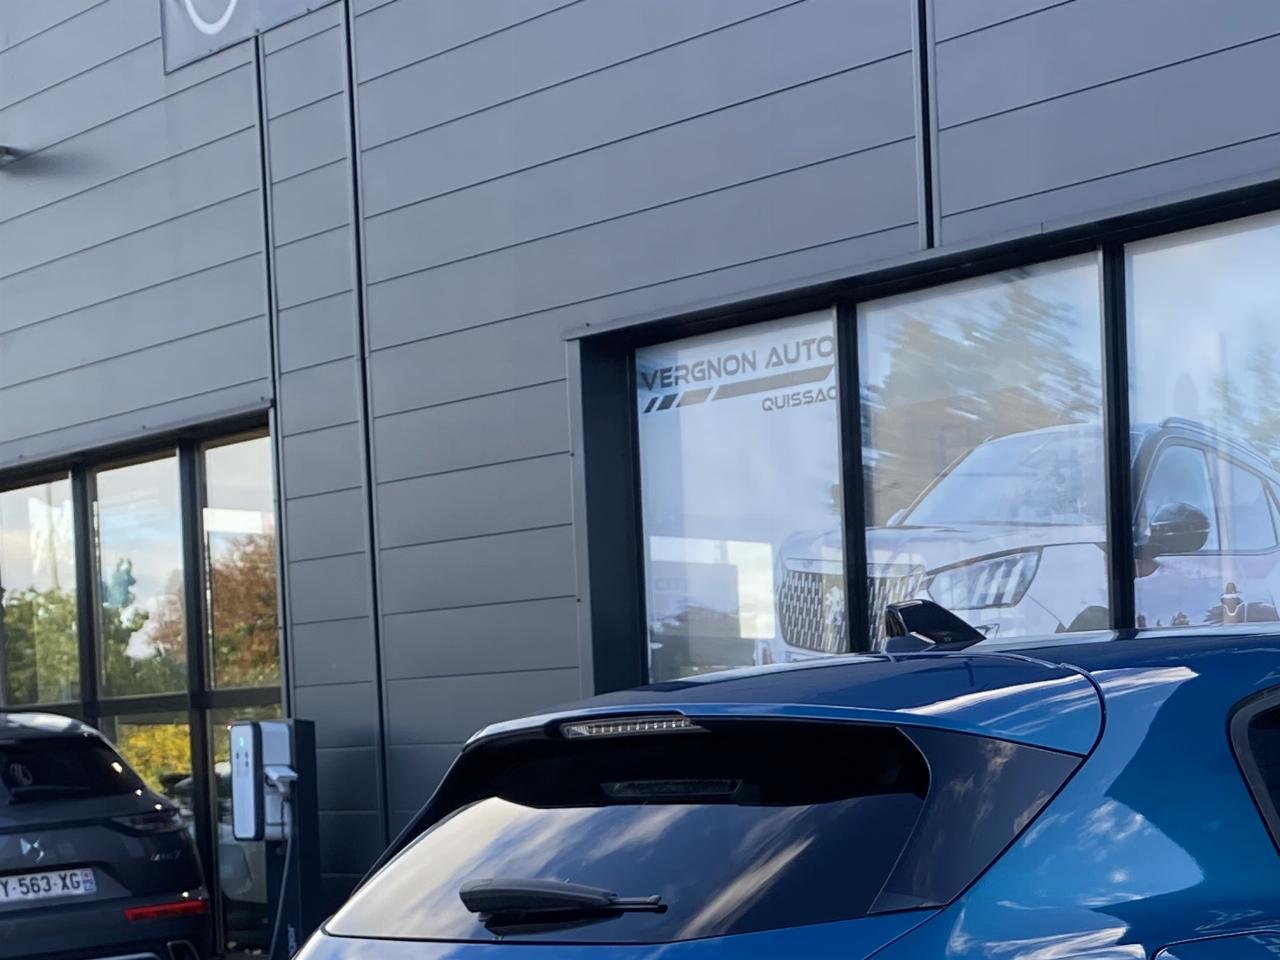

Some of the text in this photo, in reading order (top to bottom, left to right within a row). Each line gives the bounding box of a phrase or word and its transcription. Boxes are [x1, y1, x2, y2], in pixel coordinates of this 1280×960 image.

[641, 336, 834, 391] VERGNON AUTO
[762, 386, 836, 411] QUISSAC
